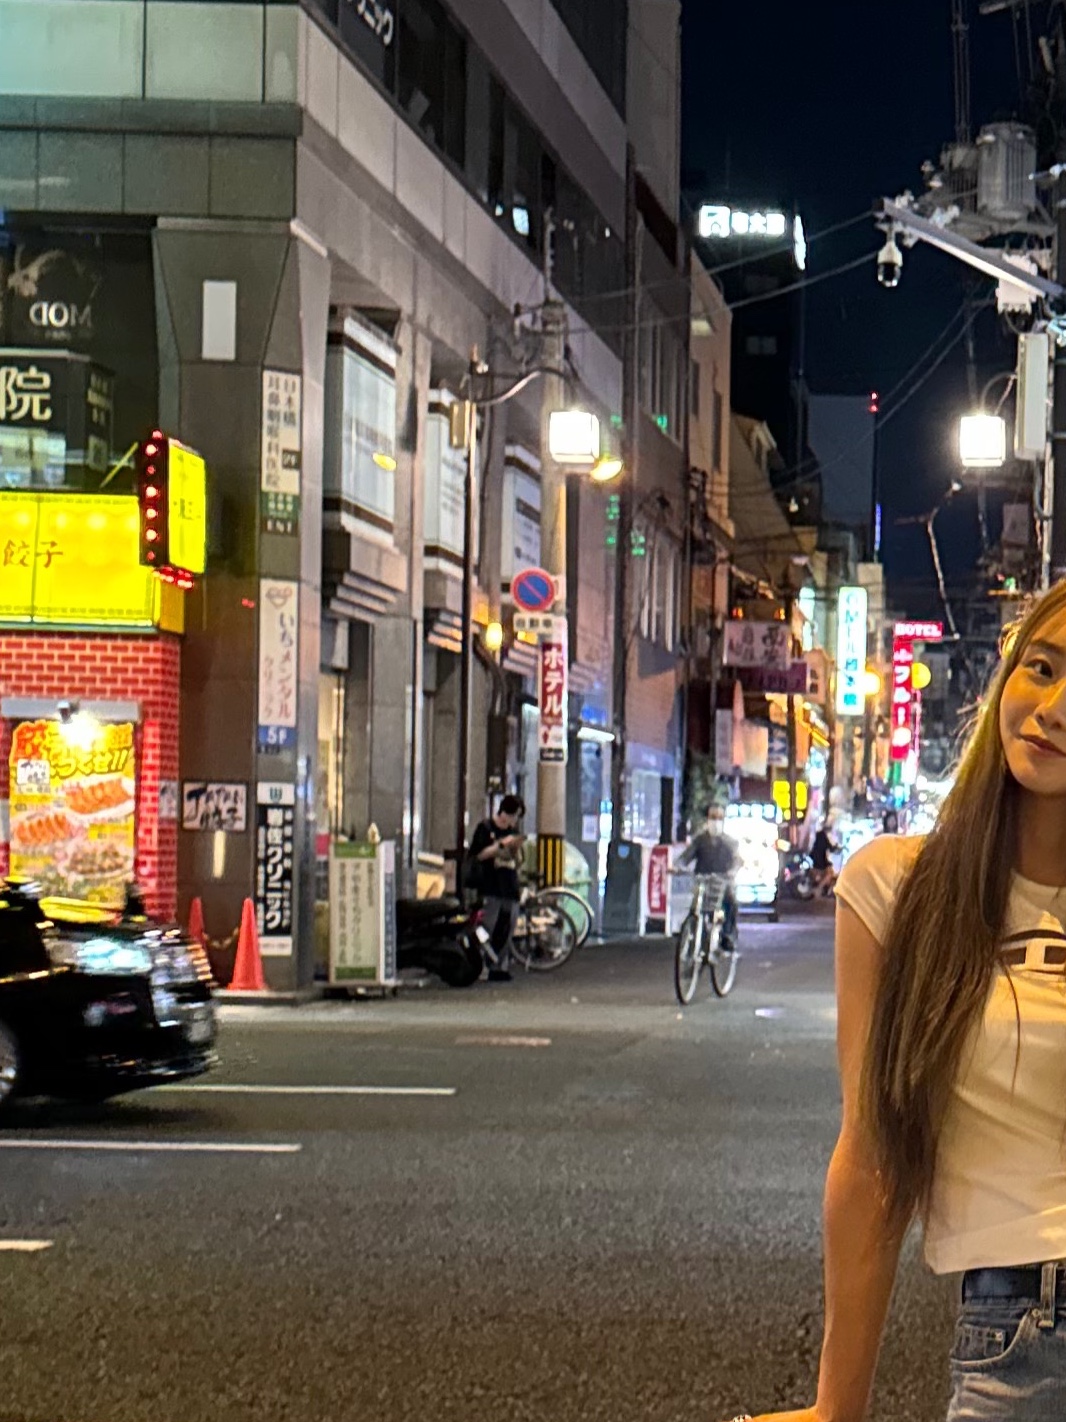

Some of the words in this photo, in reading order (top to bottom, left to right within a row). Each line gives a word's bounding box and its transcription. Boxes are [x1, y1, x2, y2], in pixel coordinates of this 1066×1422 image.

[3, 540, 63, 568] 餃子
[895, 623, 942, 636] HOTEL
[544, 647, 563, 715] ホテル
